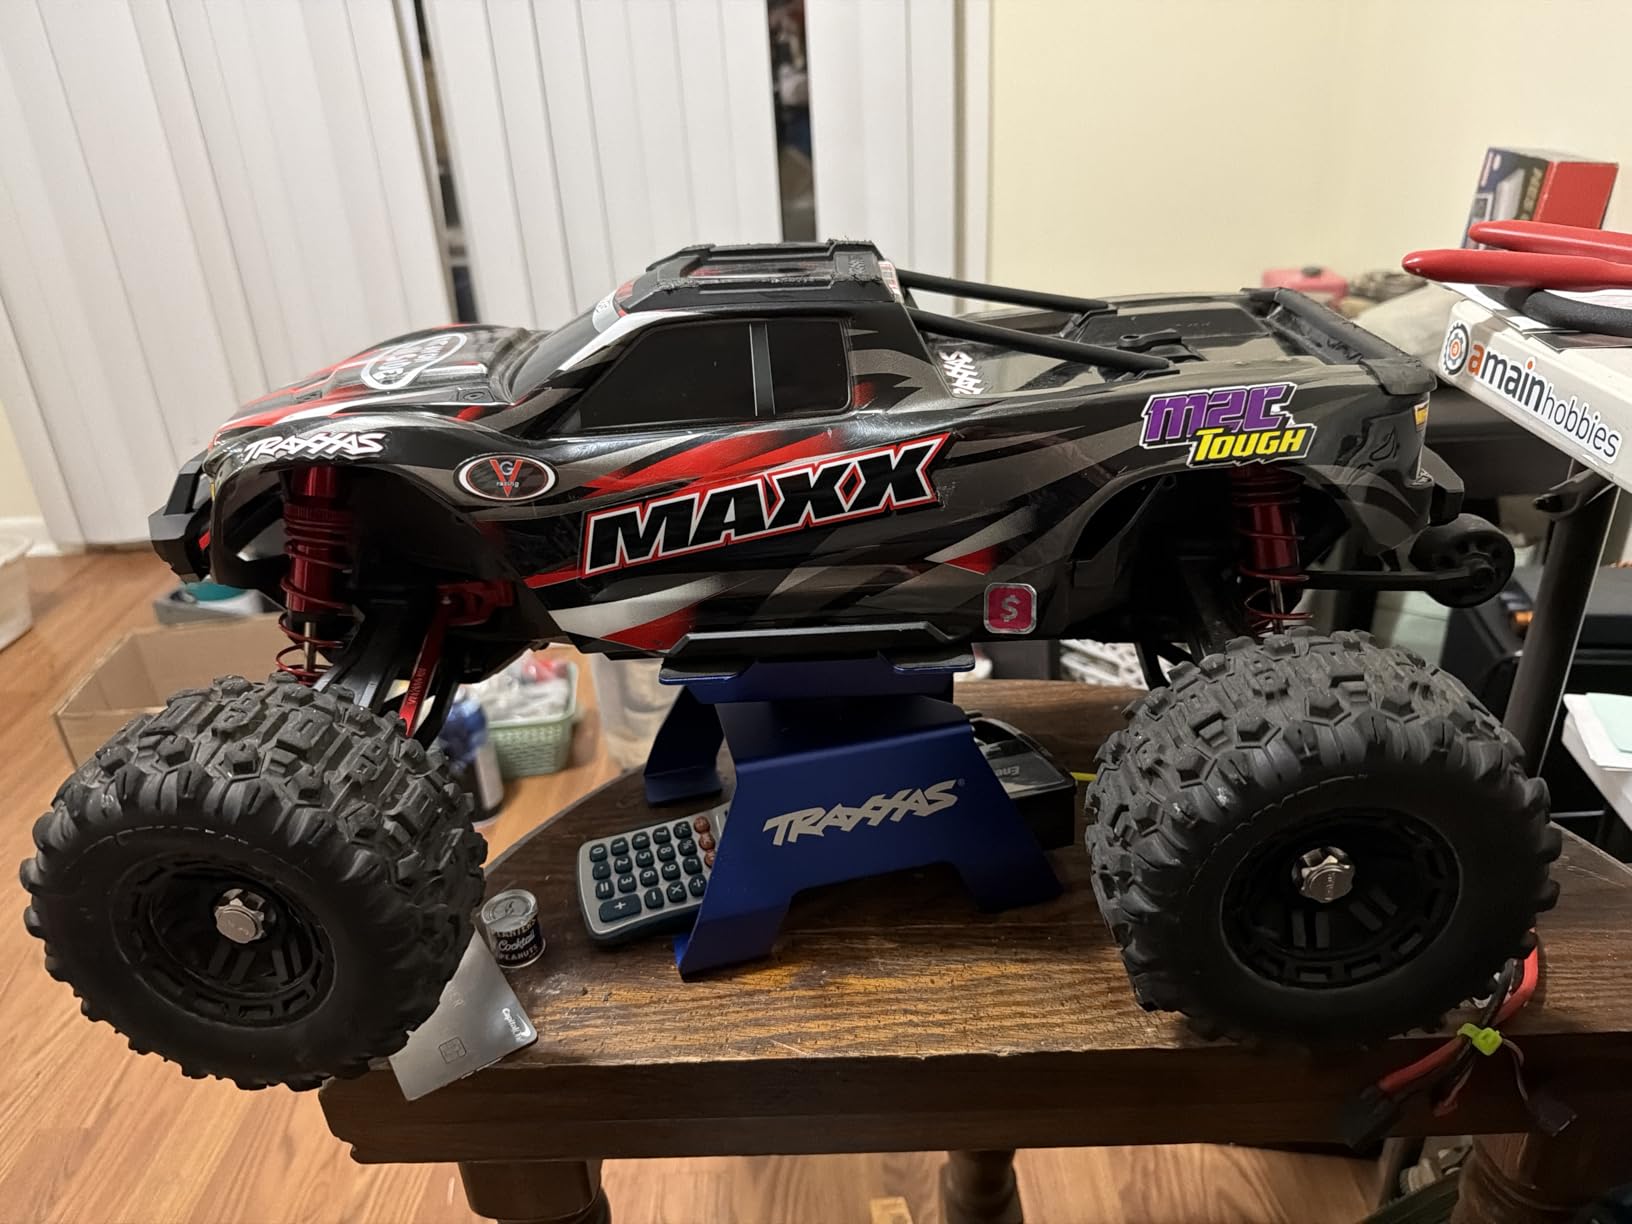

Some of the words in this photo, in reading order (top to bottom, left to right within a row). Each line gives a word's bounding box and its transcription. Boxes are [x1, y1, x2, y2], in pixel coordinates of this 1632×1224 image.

[243, 432, 387, 464] TRAXXAS
[1195, 428, 1307, 462] TOUGH
[583, 433, 950, 577] MAXX
[763, 780, 958, 846] TRAXXAS
